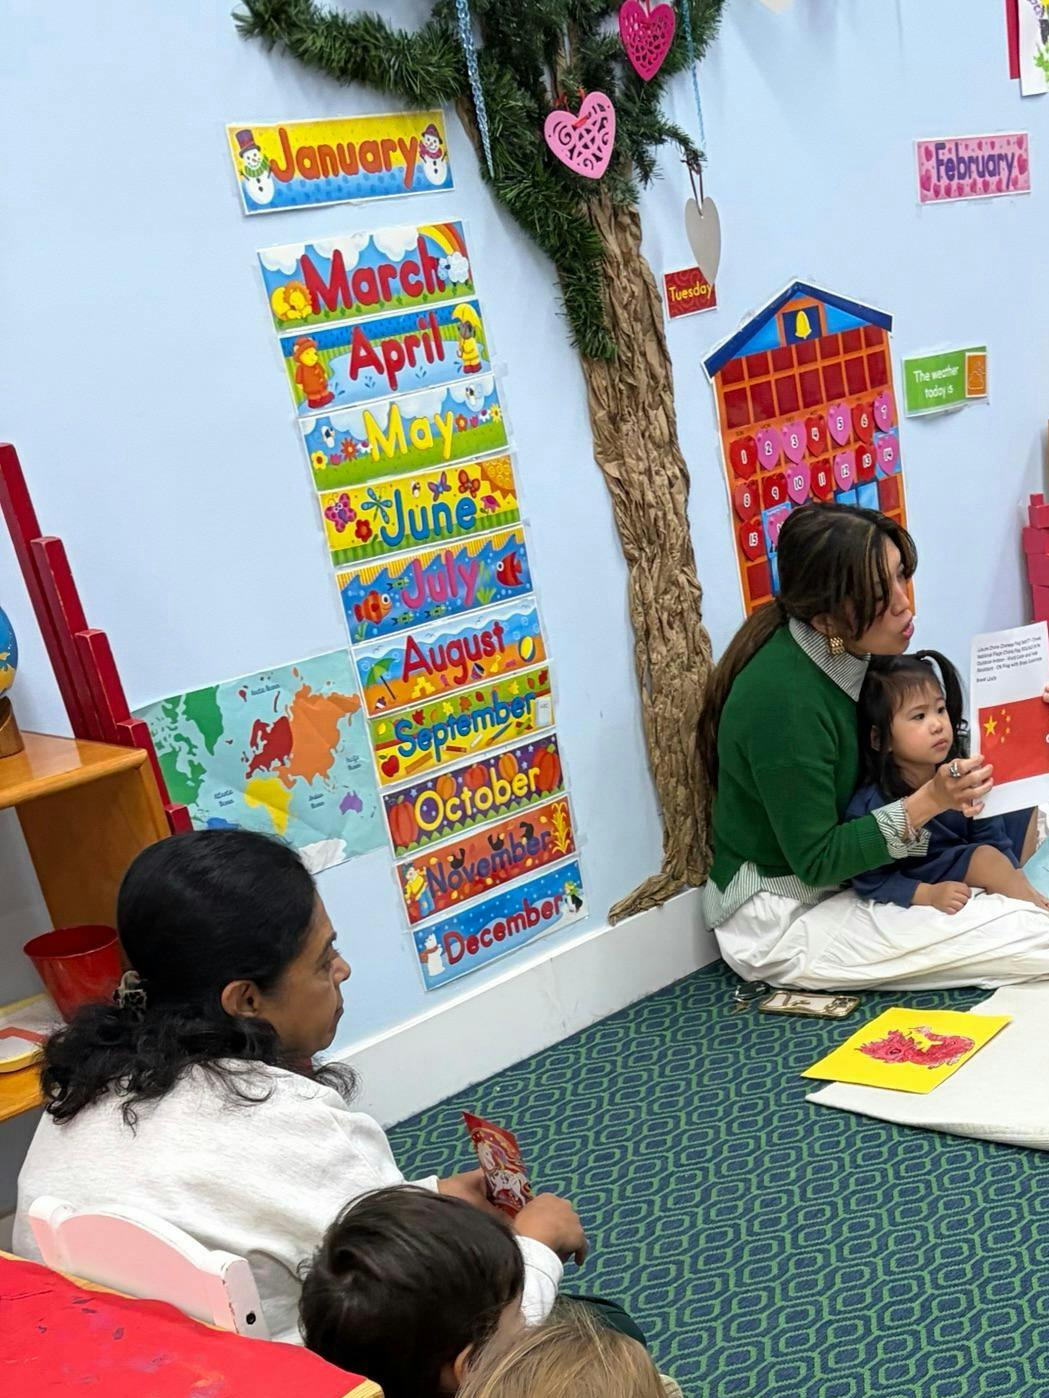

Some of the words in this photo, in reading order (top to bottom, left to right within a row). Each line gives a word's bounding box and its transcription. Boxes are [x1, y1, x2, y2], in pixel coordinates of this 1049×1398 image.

[271, 127, 418, 189] January
[934, 141, 1015, 190] February
[300, 237, 446, 316] March
[668, 280, 712, 302] Tuesday
[349, 311, 444, 391] April
[912, 369, 931, 383] The
[931, 364, 960, 380] weather
[924, 384, 946, 399] today
[946, 383, 954, 394] is
[362, 404, 454, 462] May
[765, 440, 772, 456] 2
[791, 434, 798, 448] 3
[771, 486, 779, 500] 9
[794, 475, 804, 491] 10
[379, 489, 477, 547] June
[401, 550, 479, 609] July
[402, 620, 505, 684] August
[395, 690, 536, 763] September
[413, 764, 540, 831] October
[425, 828, 550, 900] November
[443, 895, 562, 966] December
